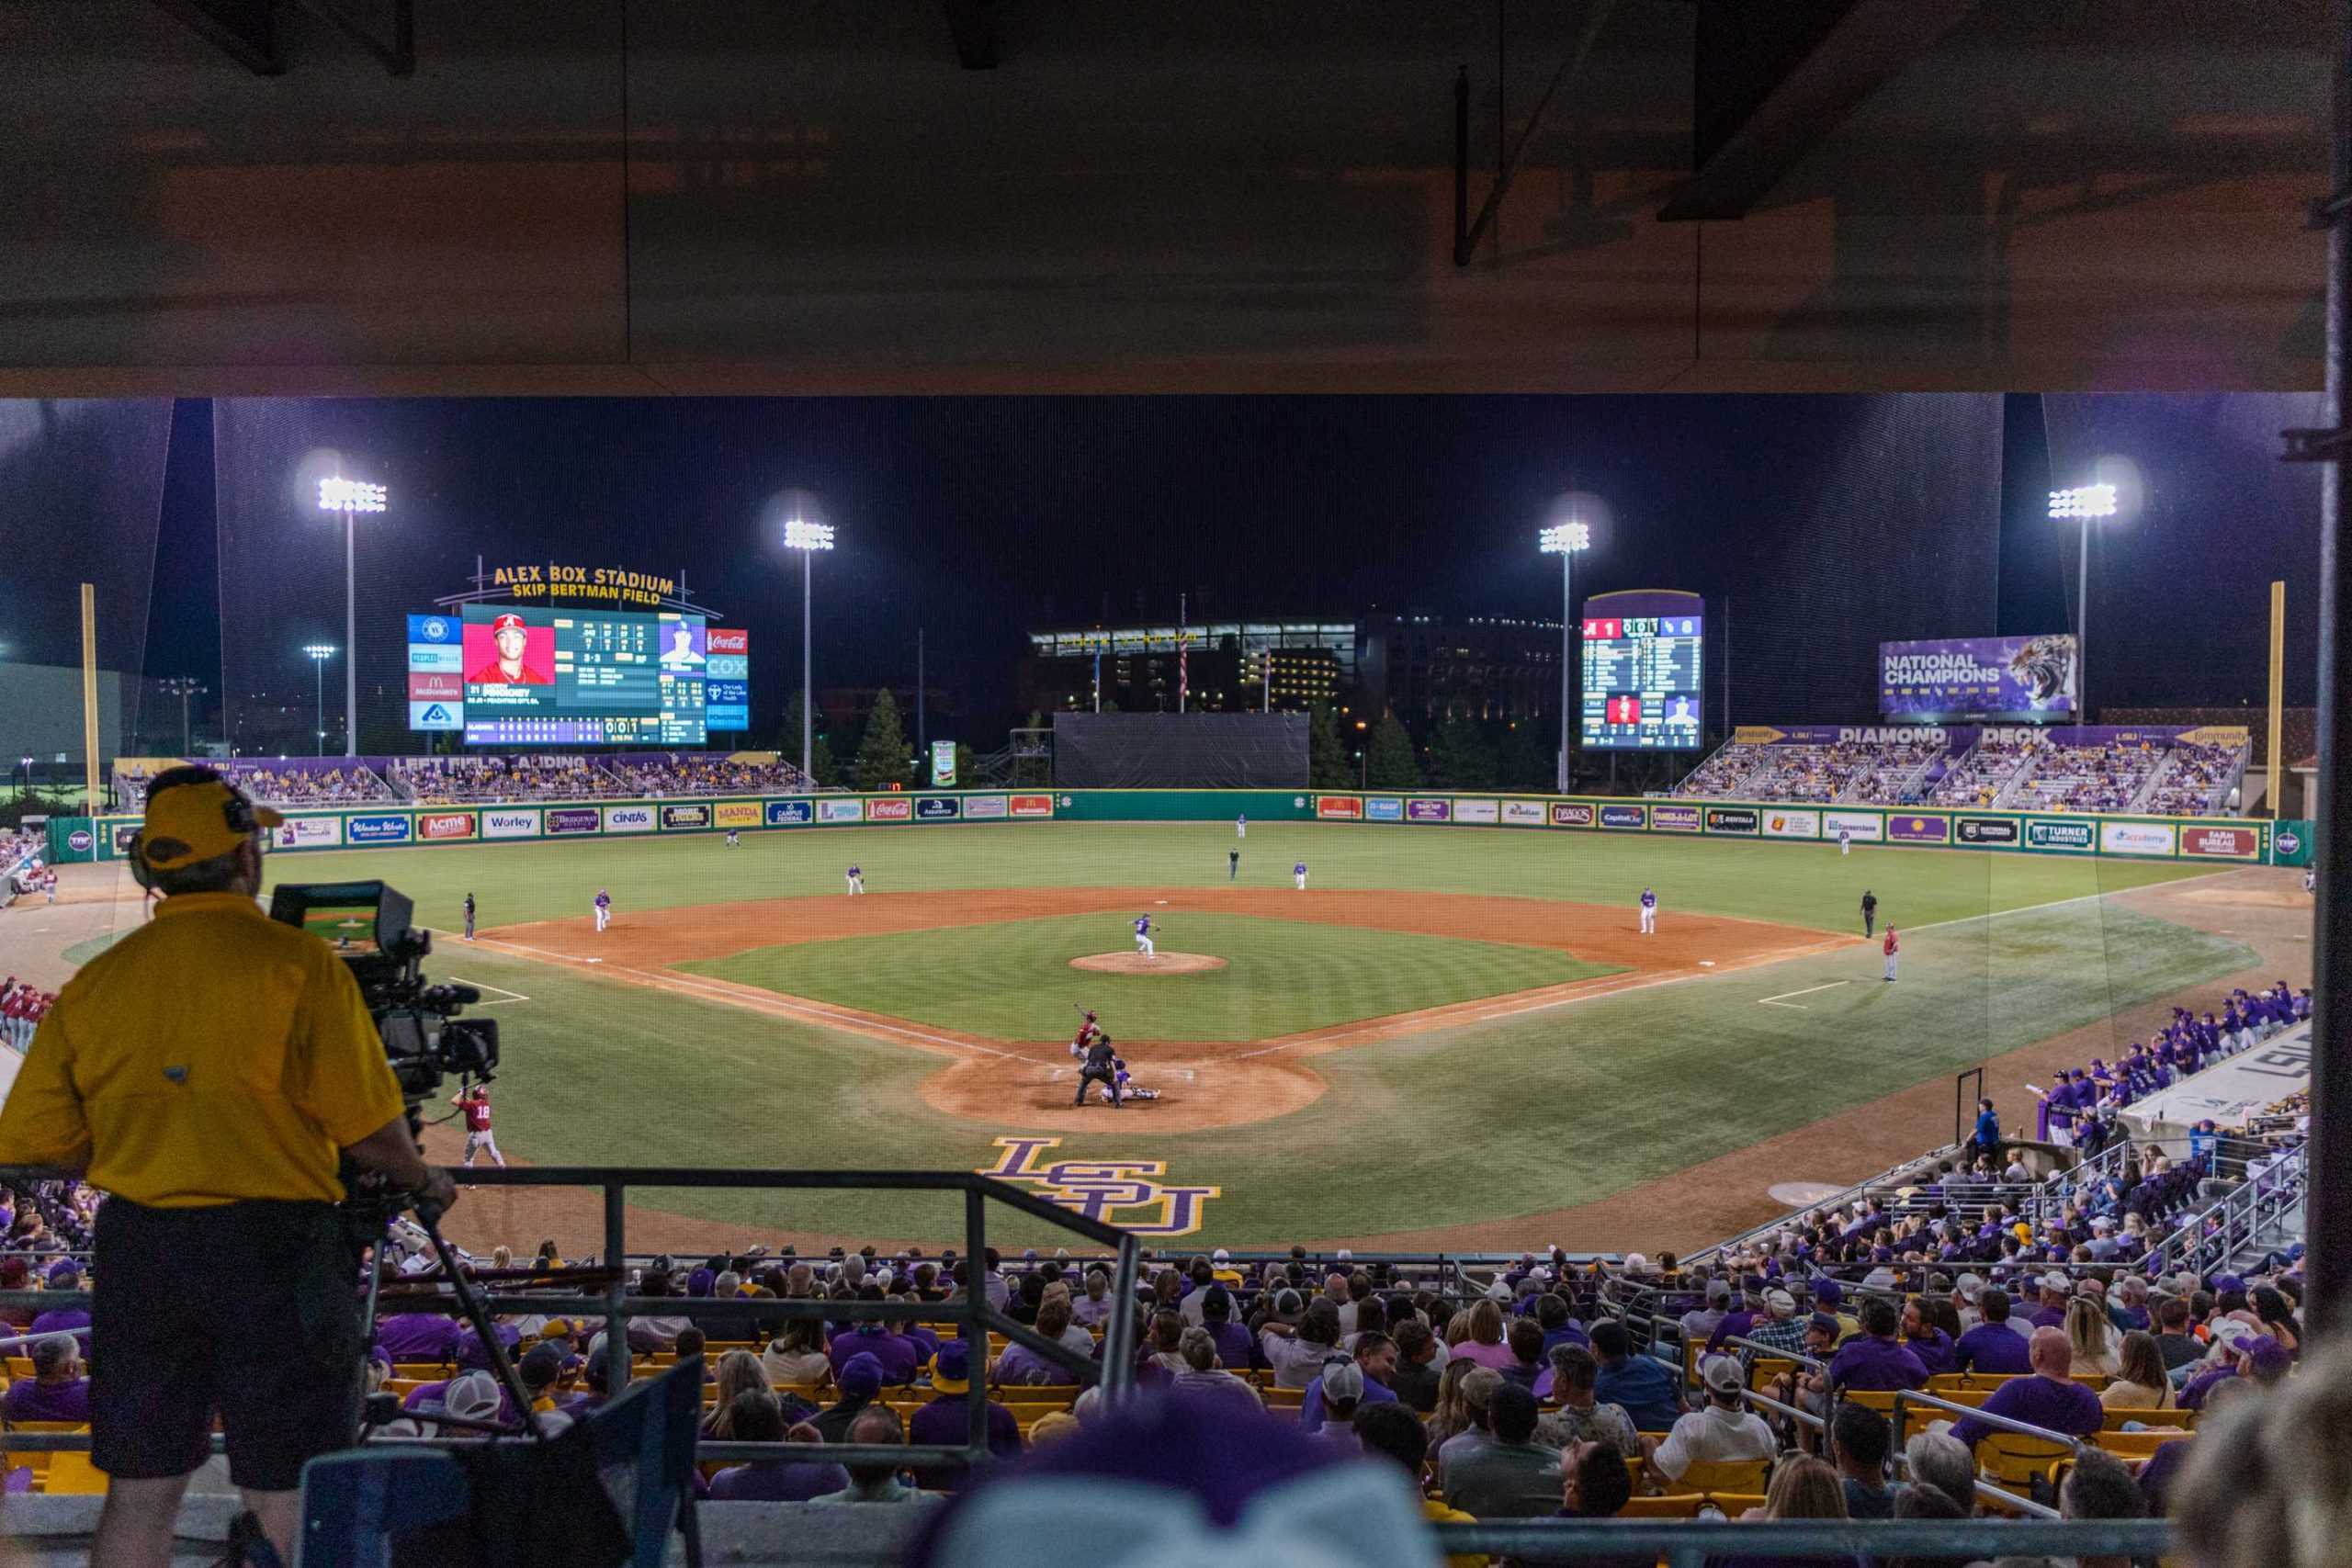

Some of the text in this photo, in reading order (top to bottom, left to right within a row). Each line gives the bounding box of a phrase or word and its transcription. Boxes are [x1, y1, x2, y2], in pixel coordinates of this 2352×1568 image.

[494, 566, 673, 595] ALEX BOX STADIUM
[513, 583, 661, 605] SKIP BERTMAN FIELD
[1605, 622, 1613, 636] 1
[1623, 623, 1632, 633] 0
[1637, 623, 1646, 633] 0
[708, 660, 747, 674] COX
[1884, 654, 1978, 671] NATIONAL
[1884, 668, 2000, 685] CHAMPIONS
[605, 722, 637, 733] 0 0 1
[1839, 728, 1946, 744] DIAMOND
[1981, 728, 2052, 743] DECK
[394, 757, 444, 774] LEFT
[719, 807, 758, 818] MANDA
[428, 815, 466, 831] Acme
[492, 815, 533, 829] Worley
[2048, 825, 2088, 836] TURNER
[2209, 830, 2234, 839] FARM
[2047, 834, 2088, 843] INDUSTRIES
[2198, 837, 2235, 846] BUREAU
[973, 1137, 1221, 1236] LSU
